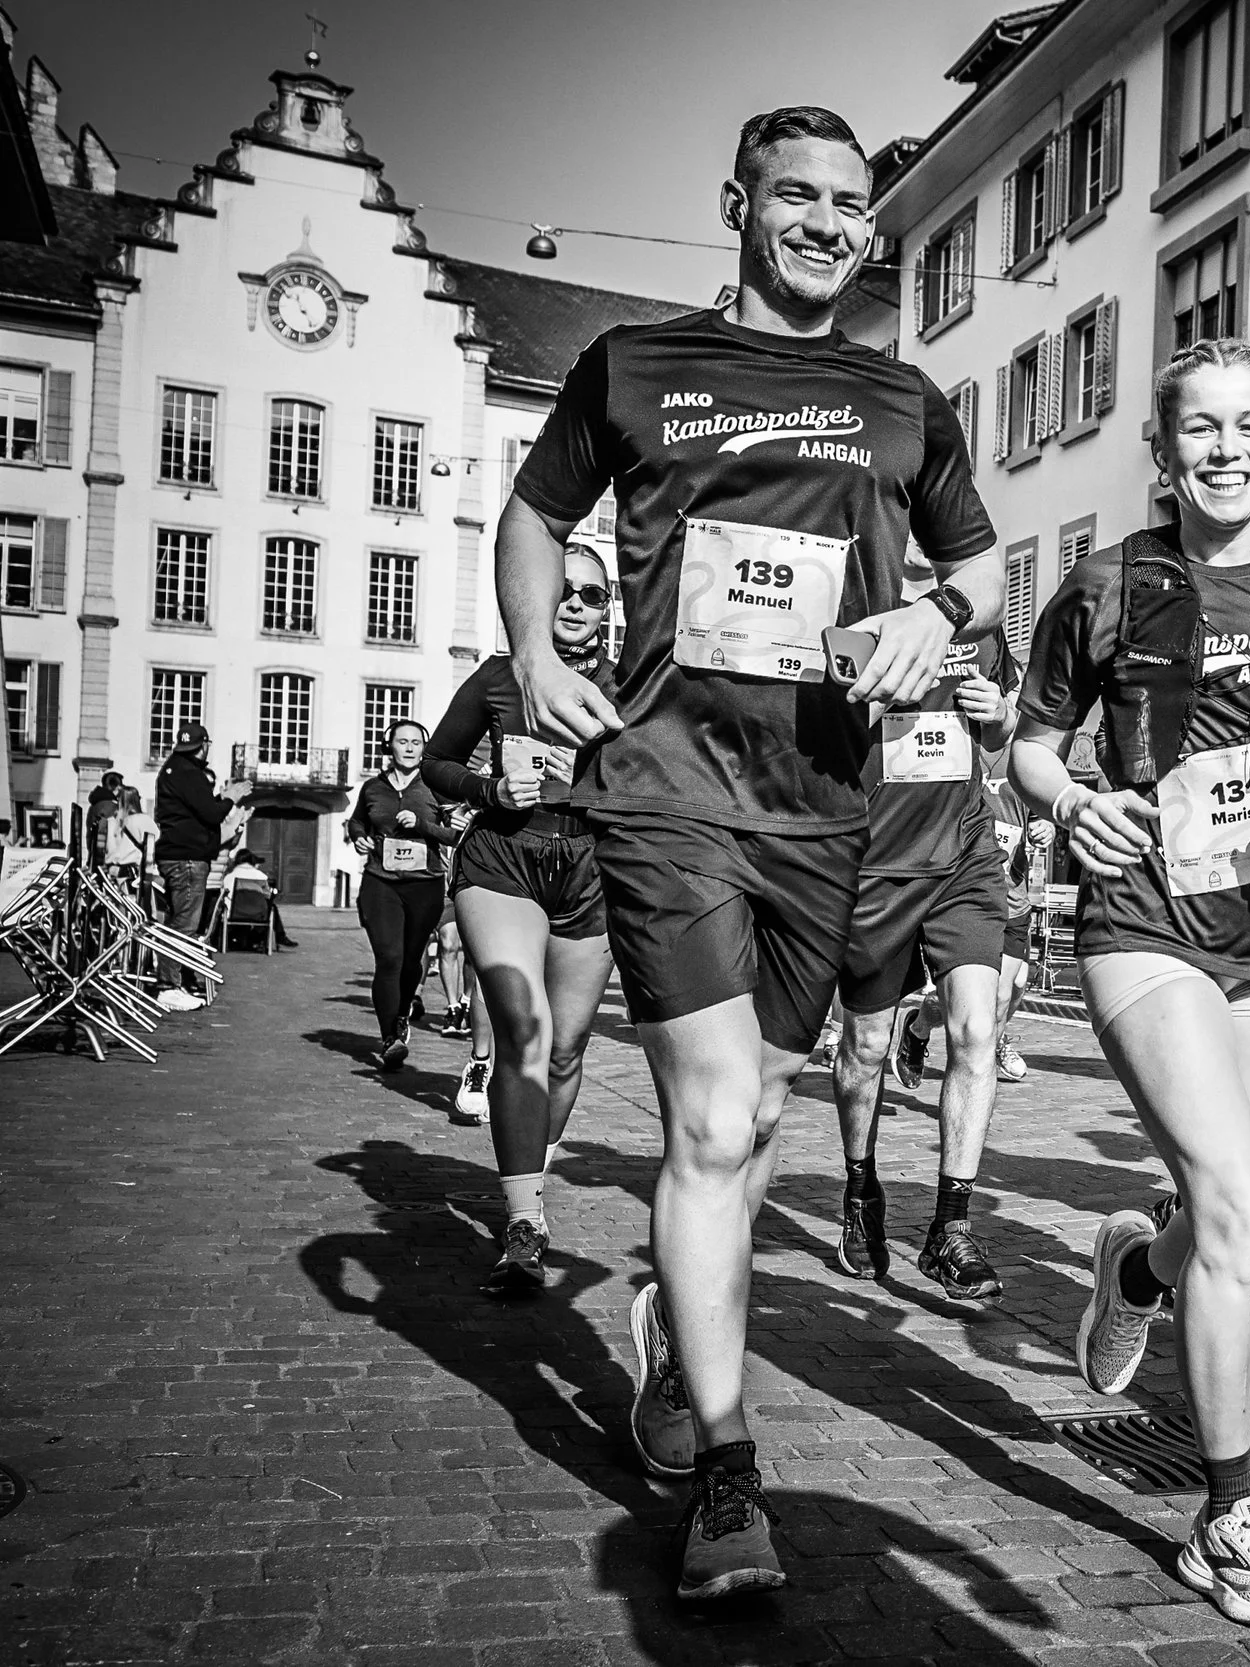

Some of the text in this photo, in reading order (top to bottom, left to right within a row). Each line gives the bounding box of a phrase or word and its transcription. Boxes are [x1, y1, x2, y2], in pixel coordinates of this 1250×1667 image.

[661, 392, 713, 408] JAKO
[662, 405, 863, 446] Kantonspolizei
[797, 440, 872, 467] AARGAU
[734, 558, 794, 589] 139
[727, 588, 793, 611] Manuel
[777, 657, 802, 671] 139
[1127, 651, 1173, 666] SALOMON
[914, 731, 946, 746] 158
[917, 749, 945, 758] Kevin
